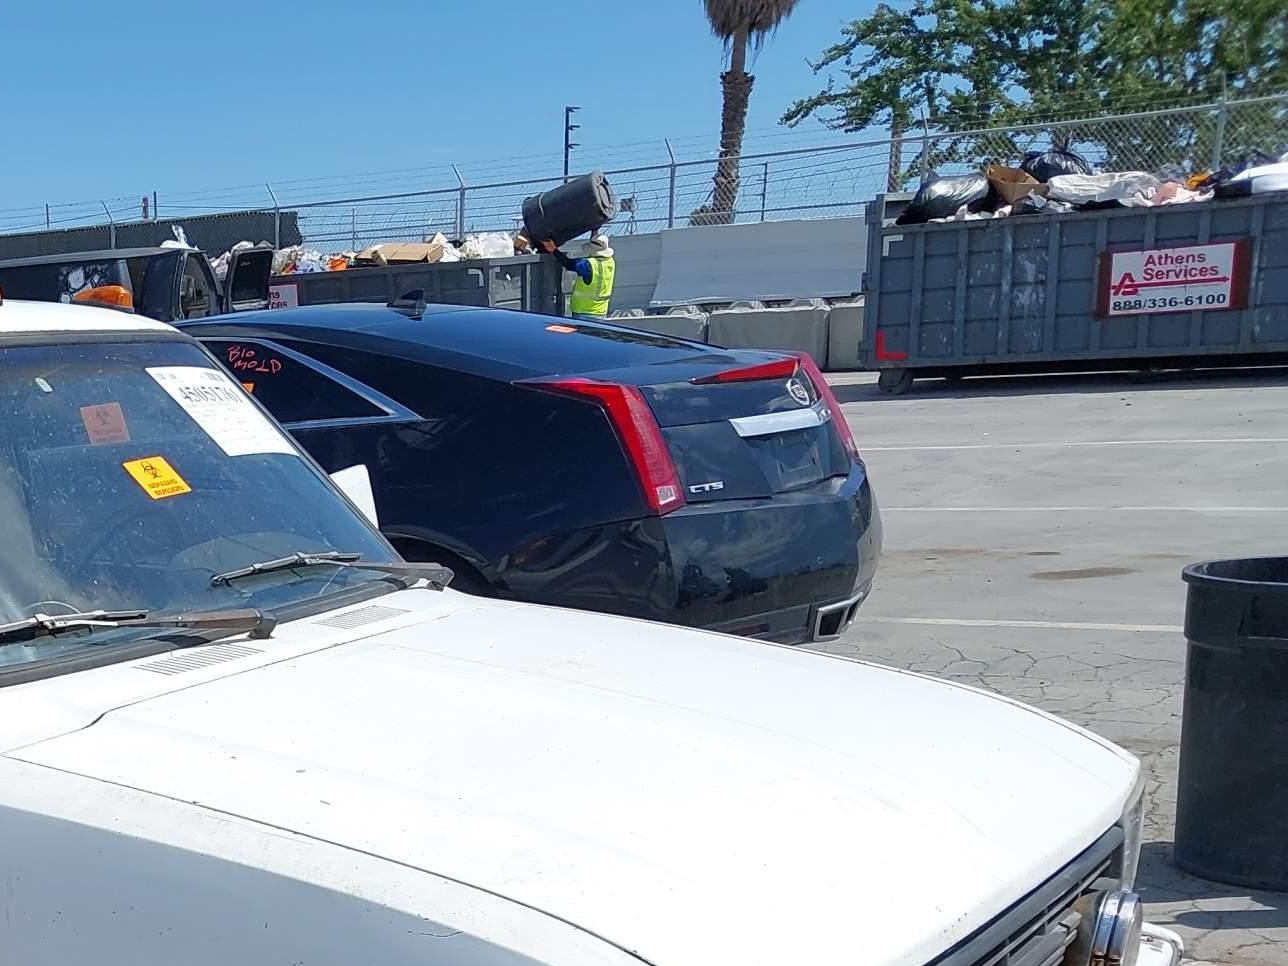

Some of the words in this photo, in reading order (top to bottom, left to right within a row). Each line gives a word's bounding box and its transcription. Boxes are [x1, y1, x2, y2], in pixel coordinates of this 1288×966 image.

[1144, 252, 1207, 267] Athens
[1142, 265, 1220, 282] Services
[1112, 292, 1227, 312] 888/336-6100
[234, 358, 282, 374] MOLD
[688, 480, 724, 493] CTS
